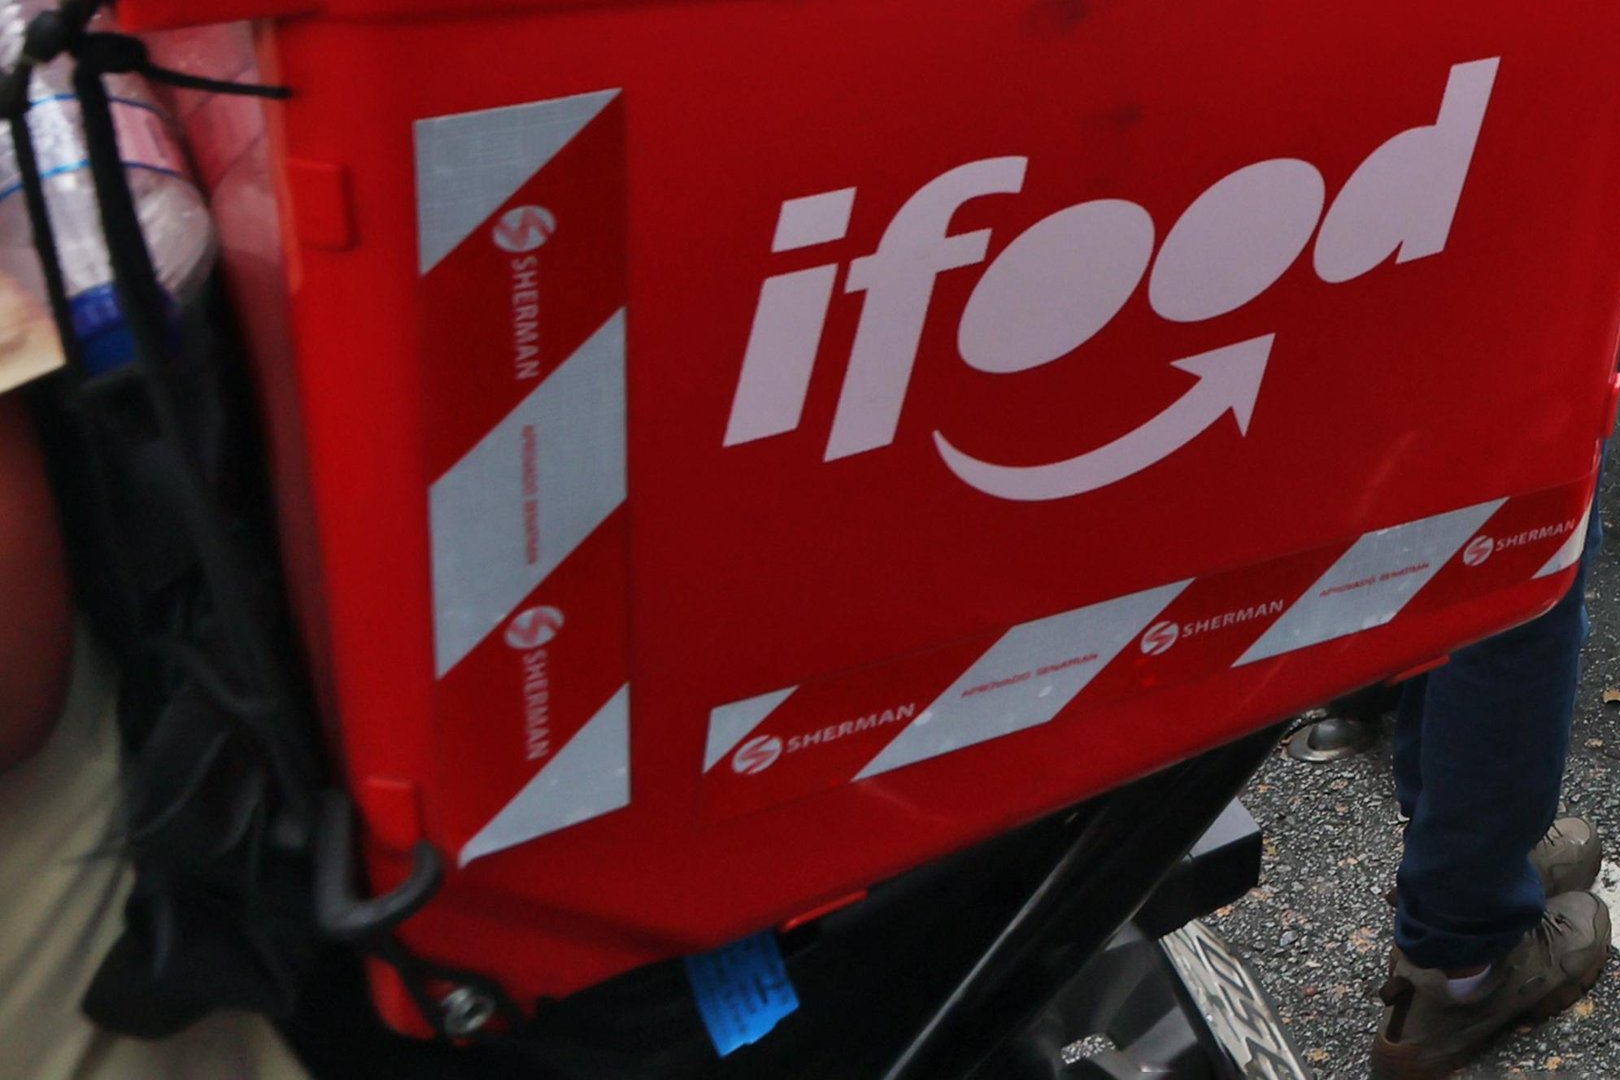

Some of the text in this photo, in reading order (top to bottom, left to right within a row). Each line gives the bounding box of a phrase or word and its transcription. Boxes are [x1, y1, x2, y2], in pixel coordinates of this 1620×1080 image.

[721, 56, 1501, 463] ifood
[510, 254, 539, 381] SHERMAN
[1495, 518, 1576, 552] SHERMAN
[1182, 599, 1284, 638] SHERMAN
[522, 650, 551, 761] SHERMAN
[786, 702, 916, 754] SHERMAN
